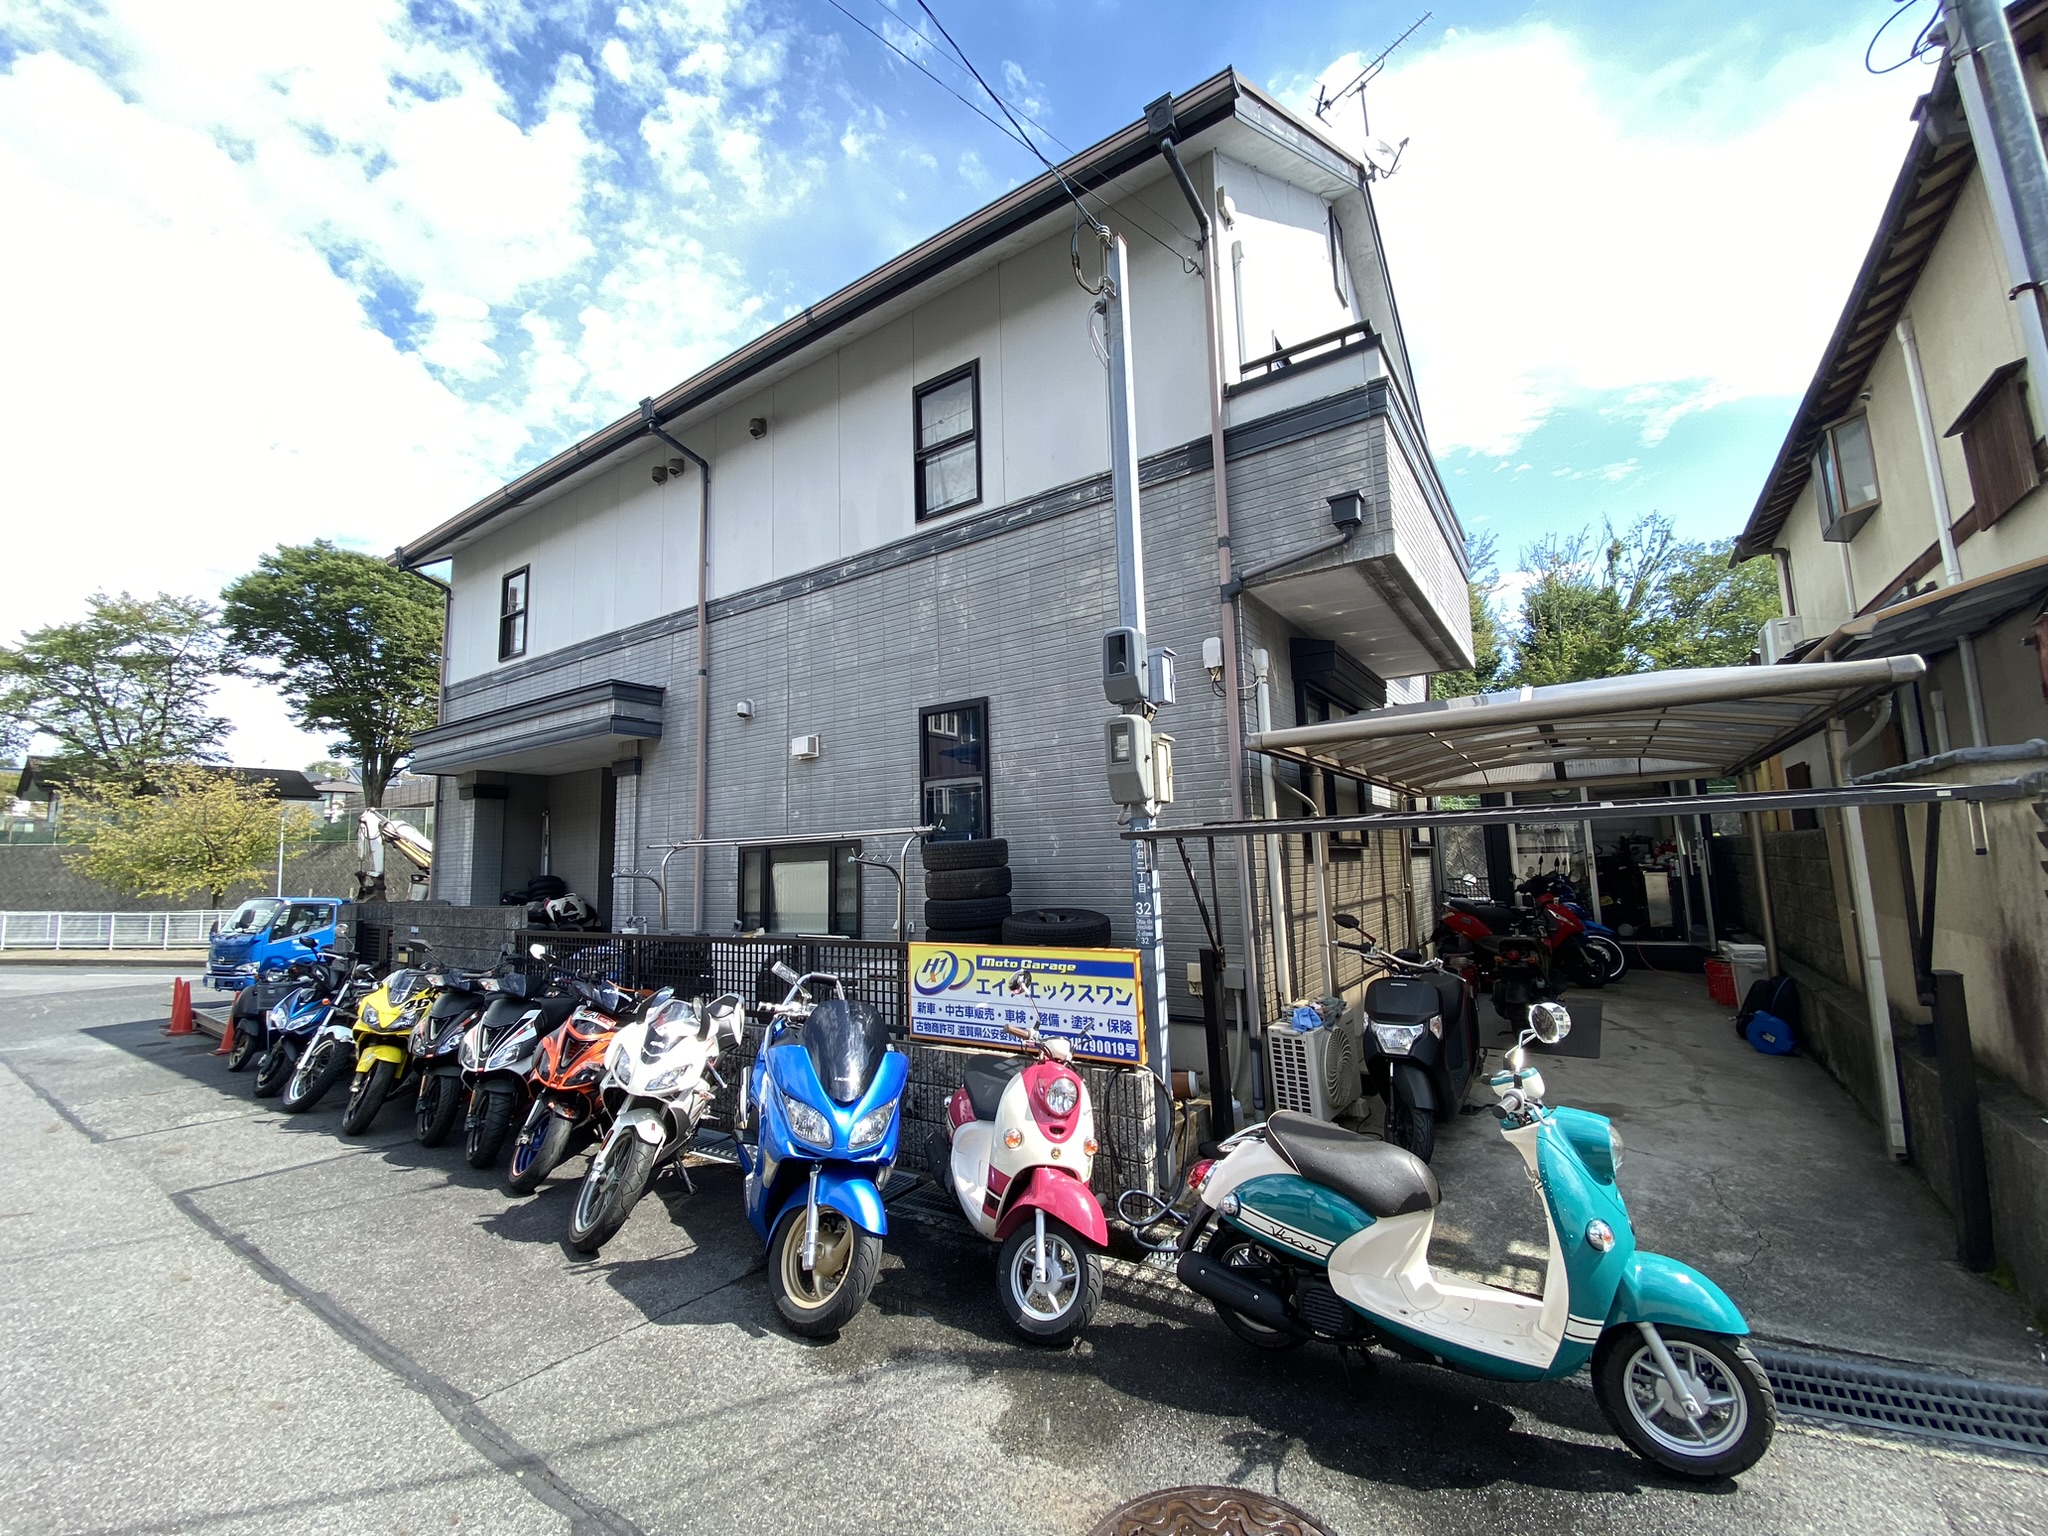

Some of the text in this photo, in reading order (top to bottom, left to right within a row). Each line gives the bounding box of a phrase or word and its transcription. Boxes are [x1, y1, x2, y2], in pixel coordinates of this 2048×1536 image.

[1134, 901, 1152, 915] 32
[1140, 936, 1150, 945] 32
[981, 957, 1076, 974] Moto Garage
[976, 978, 1133, 1006] エイエックスワン
[915, 1020, 955, 1035] 古物商許可
[957, 1024, 1022, 1043] 滋賀県公安委員
[1269, 1225, 1318, 1252] Vino
